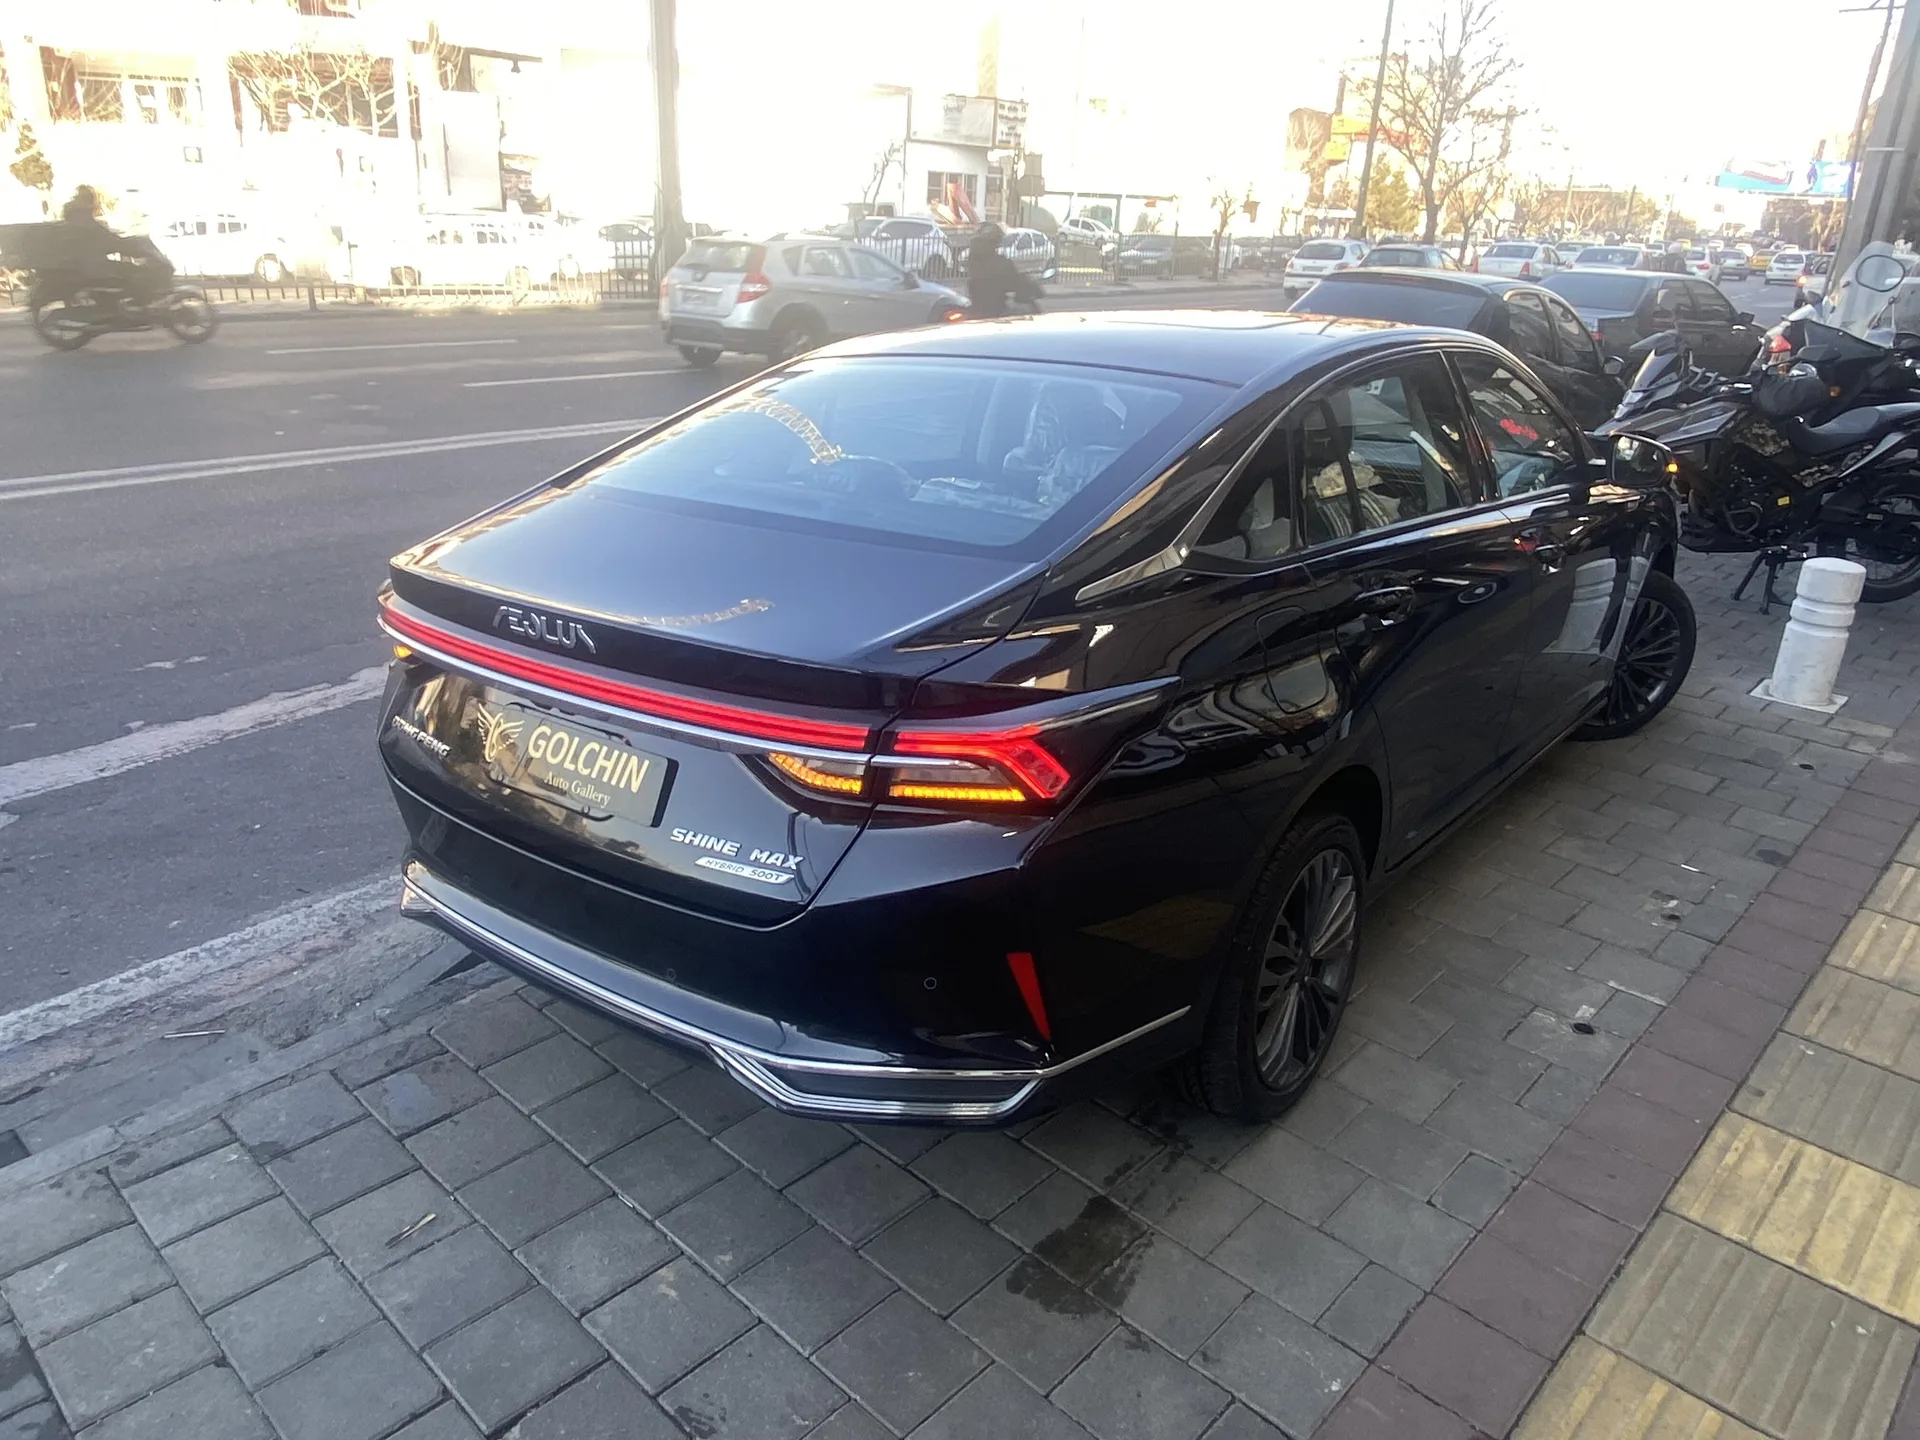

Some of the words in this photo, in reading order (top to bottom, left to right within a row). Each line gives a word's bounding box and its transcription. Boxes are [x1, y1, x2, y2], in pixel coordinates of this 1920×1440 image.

[528, 725, 650, 793] GOLCHIN
[544, 771, 569, 791] Auto
[571, 780, 612, 809] Gallery
[670, 827, 741, 857] SHINE
[749, 848, 804, 871] MAX
[705, 859, 745, 873] HYBRID
[748, 869, 784, 881] 500T
